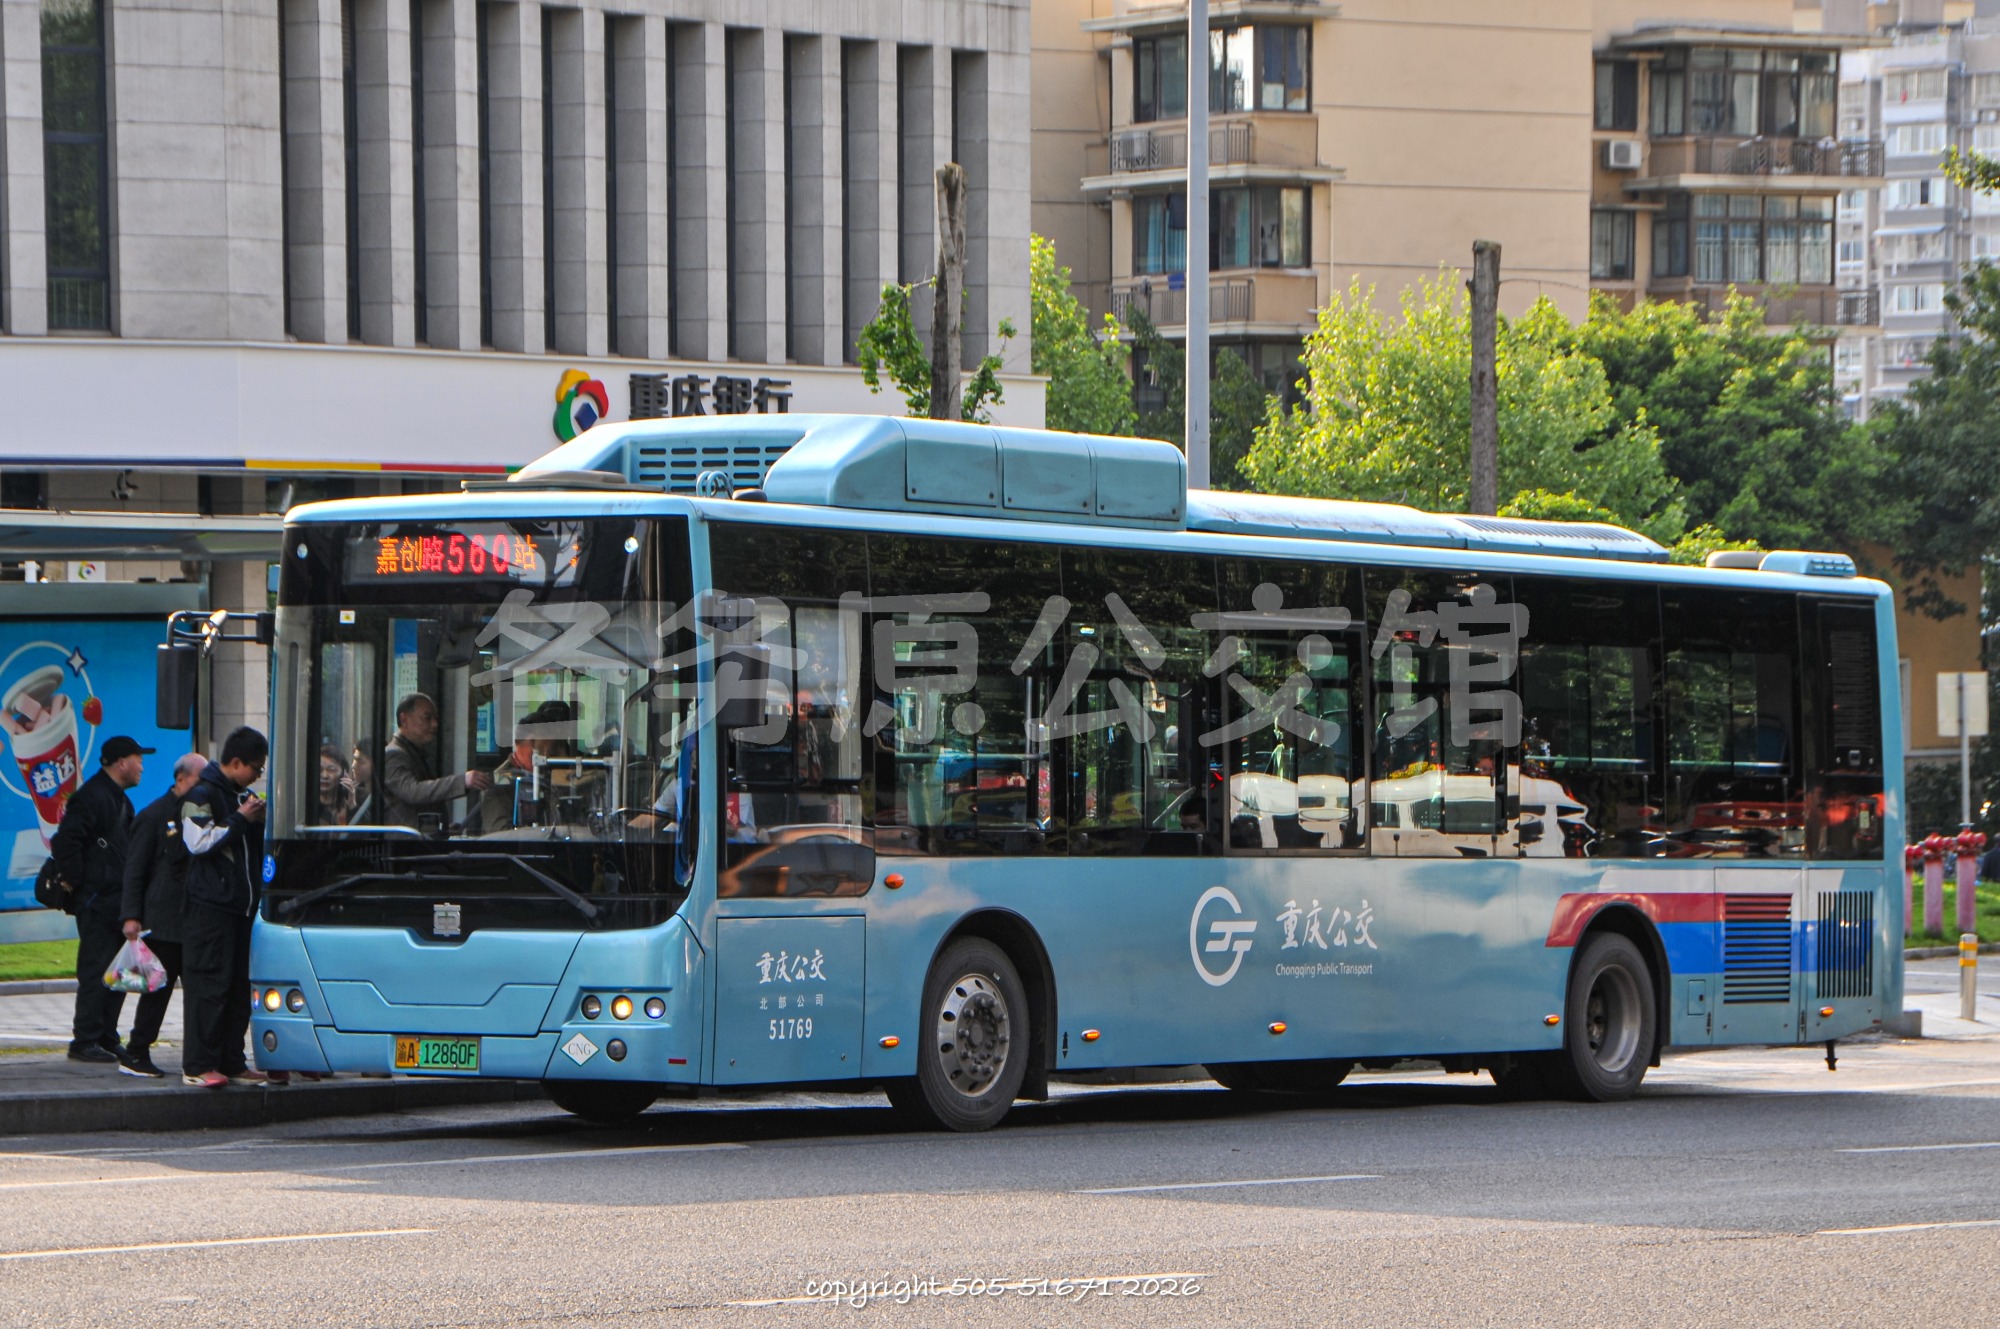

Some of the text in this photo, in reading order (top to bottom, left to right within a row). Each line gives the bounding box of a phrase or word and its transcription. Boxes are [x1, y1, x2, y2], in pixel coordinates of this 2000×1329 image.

[628, 373, 793, 421] 重庆银行
[32, 751, 76, 793] 益达
[1275, 899, 1378, 950] 重庆公交
[756, 949, 827, 984] 重庆公交
[1275, 962, 1373, 979] Chongqing Public Transport
[759, 993, 824, 1011] 北部公司
[769, 1017, 813, 1040] 51769
[567, 1042, 591, 1056] CNG
